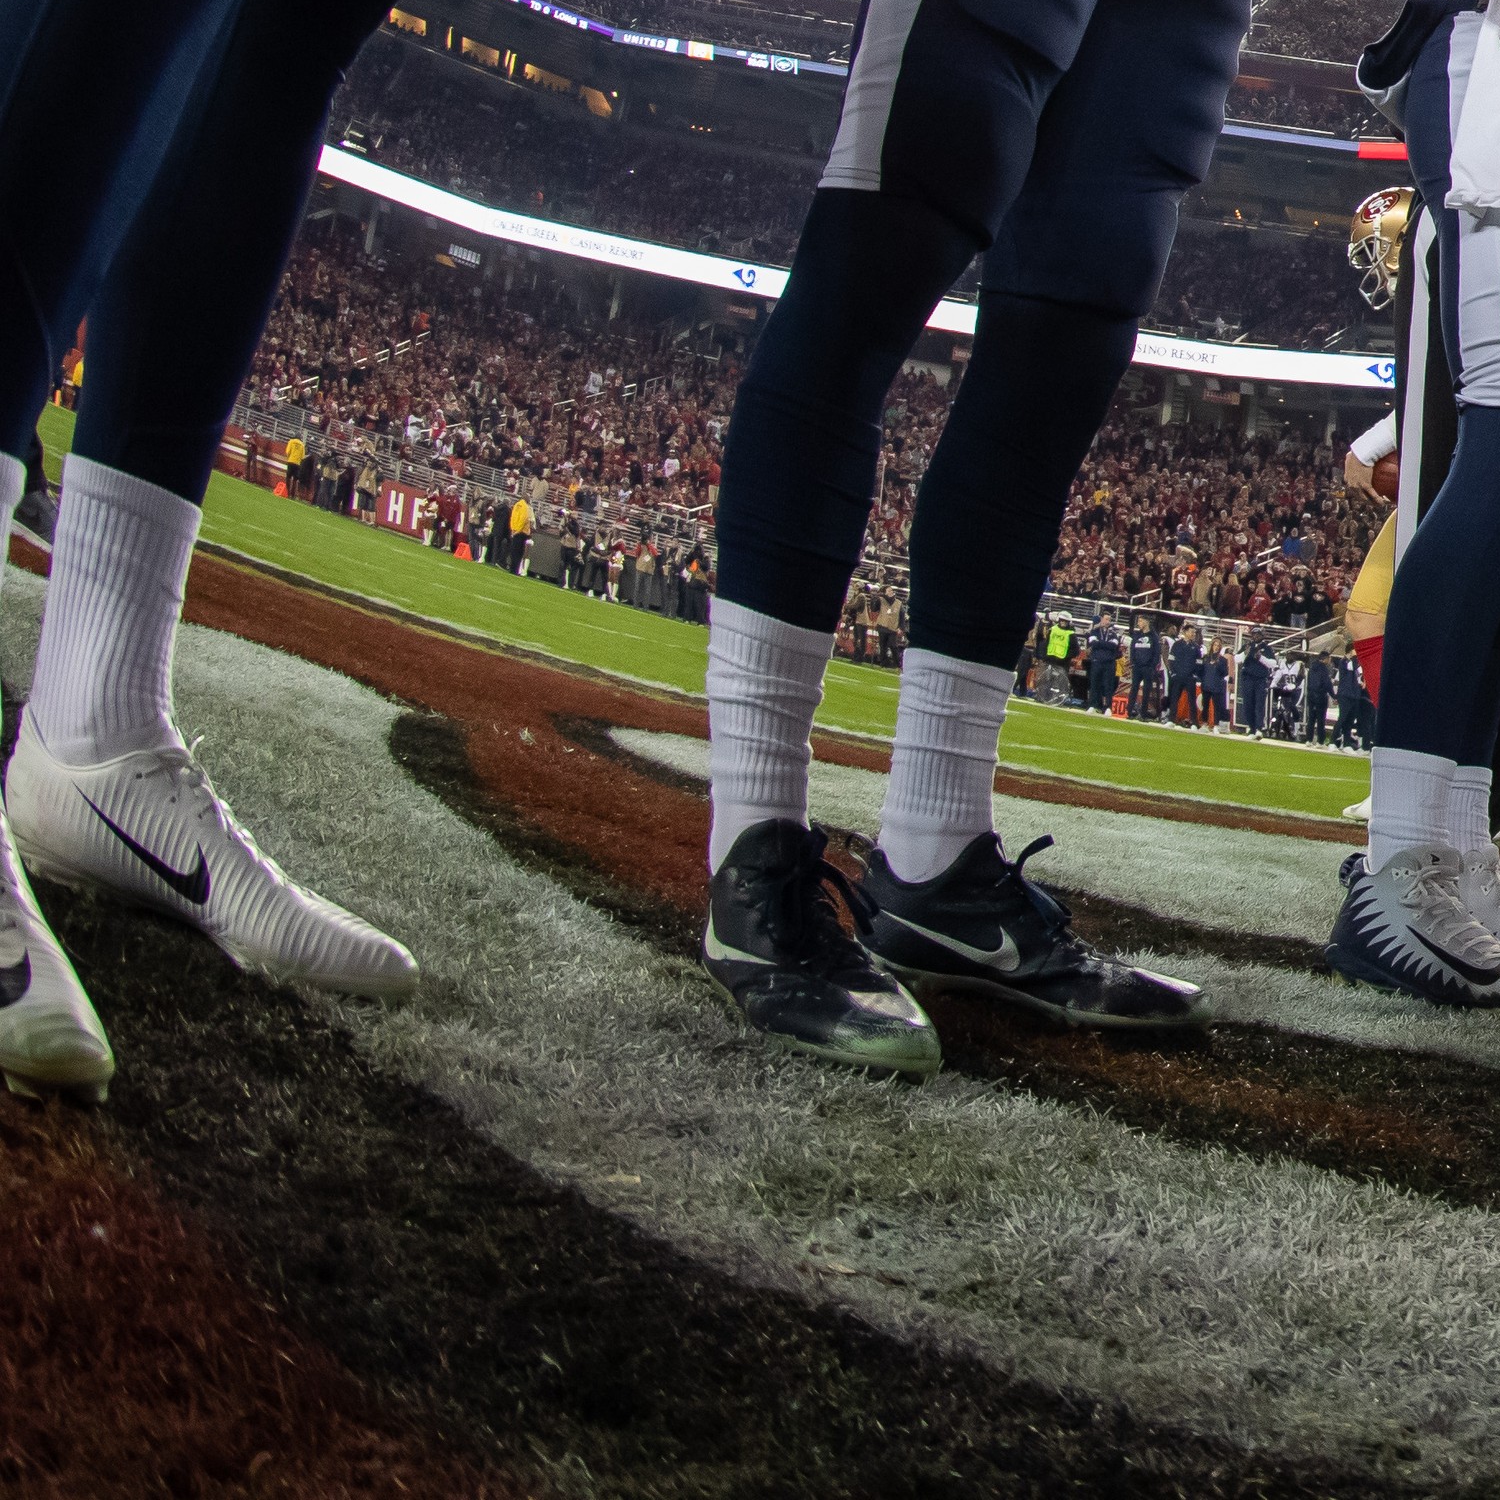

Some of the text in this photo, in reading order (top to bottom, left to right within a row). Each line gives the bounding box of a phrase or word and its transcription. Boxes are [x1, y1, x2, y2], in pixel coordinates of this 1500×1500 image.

[622, 33, 665, 49] UNITED
[527, 226, 558, 242] CREEK
[569, 236, 606, 252] CASINO
[610, 245, 644, 260] RESORT
[1171, 348, 1217, 366] RESORT
